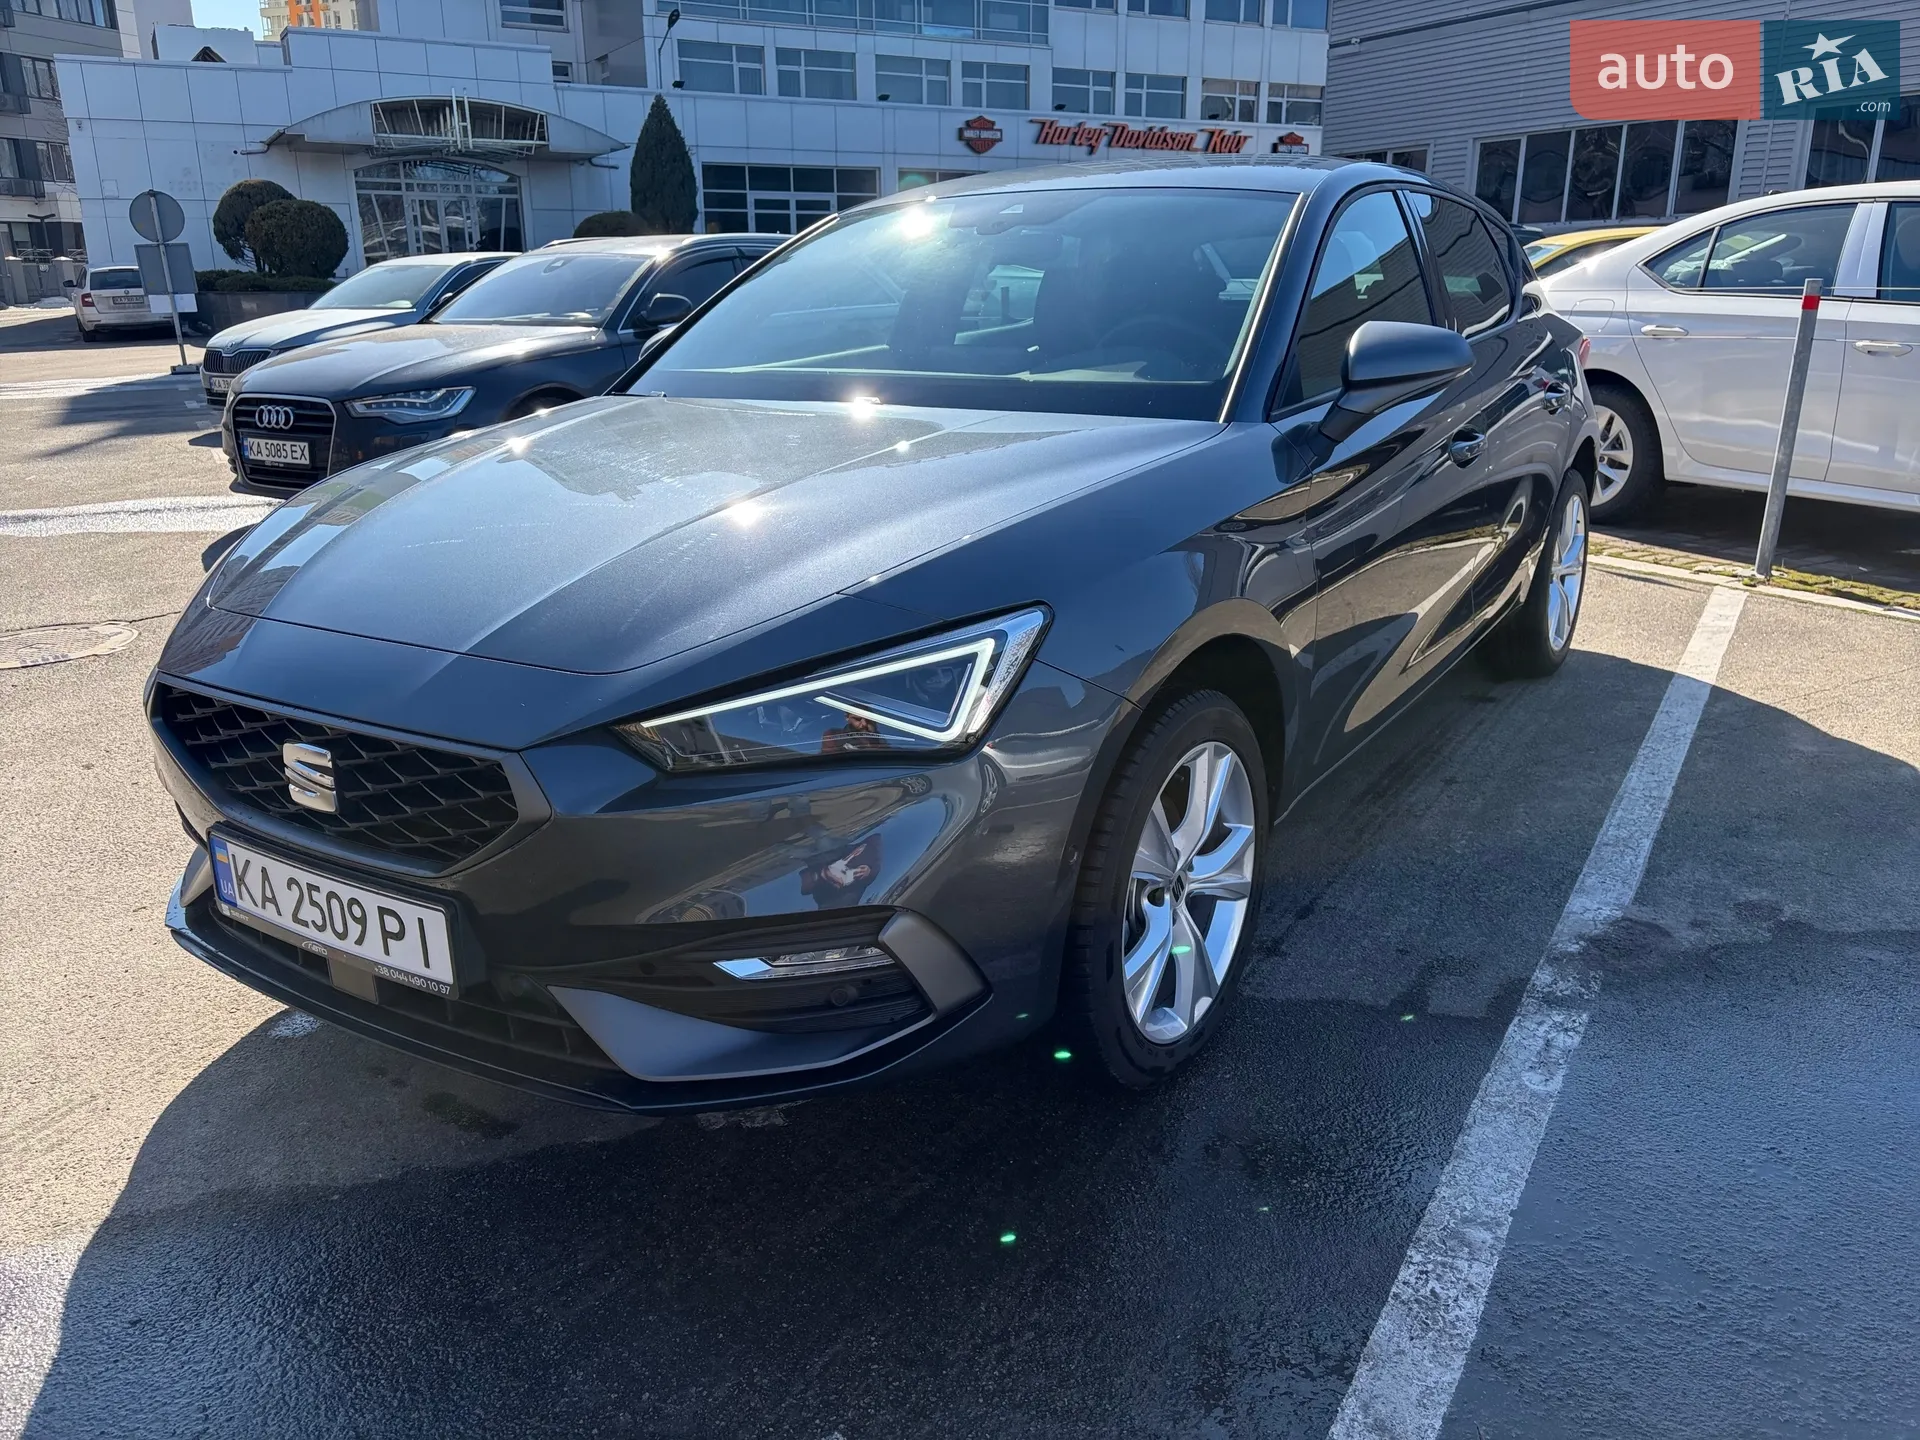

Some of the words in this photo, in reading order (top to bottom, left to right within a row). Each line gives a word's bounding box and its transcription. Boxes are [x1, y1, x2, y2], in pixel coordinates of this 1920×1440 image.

[213, 379, 222, 389] KA
[248, 439, 262, 457] KA
[265, 441, 288, 459] 5085
[290, 444, 307, 461] EX
[220, 879, 235, 897] UA
[231, 854, 282, 916] KA
[287, 877, 367, 946] 2509
[377, 905, 431, 969] PI
[374, 965, 389, 977] +38
[390, 969, 408, 982] 044
[409, 975, 427, 988] 490
[427, 981, 438, 991] 10
[440, 984, 450, 995] 97
